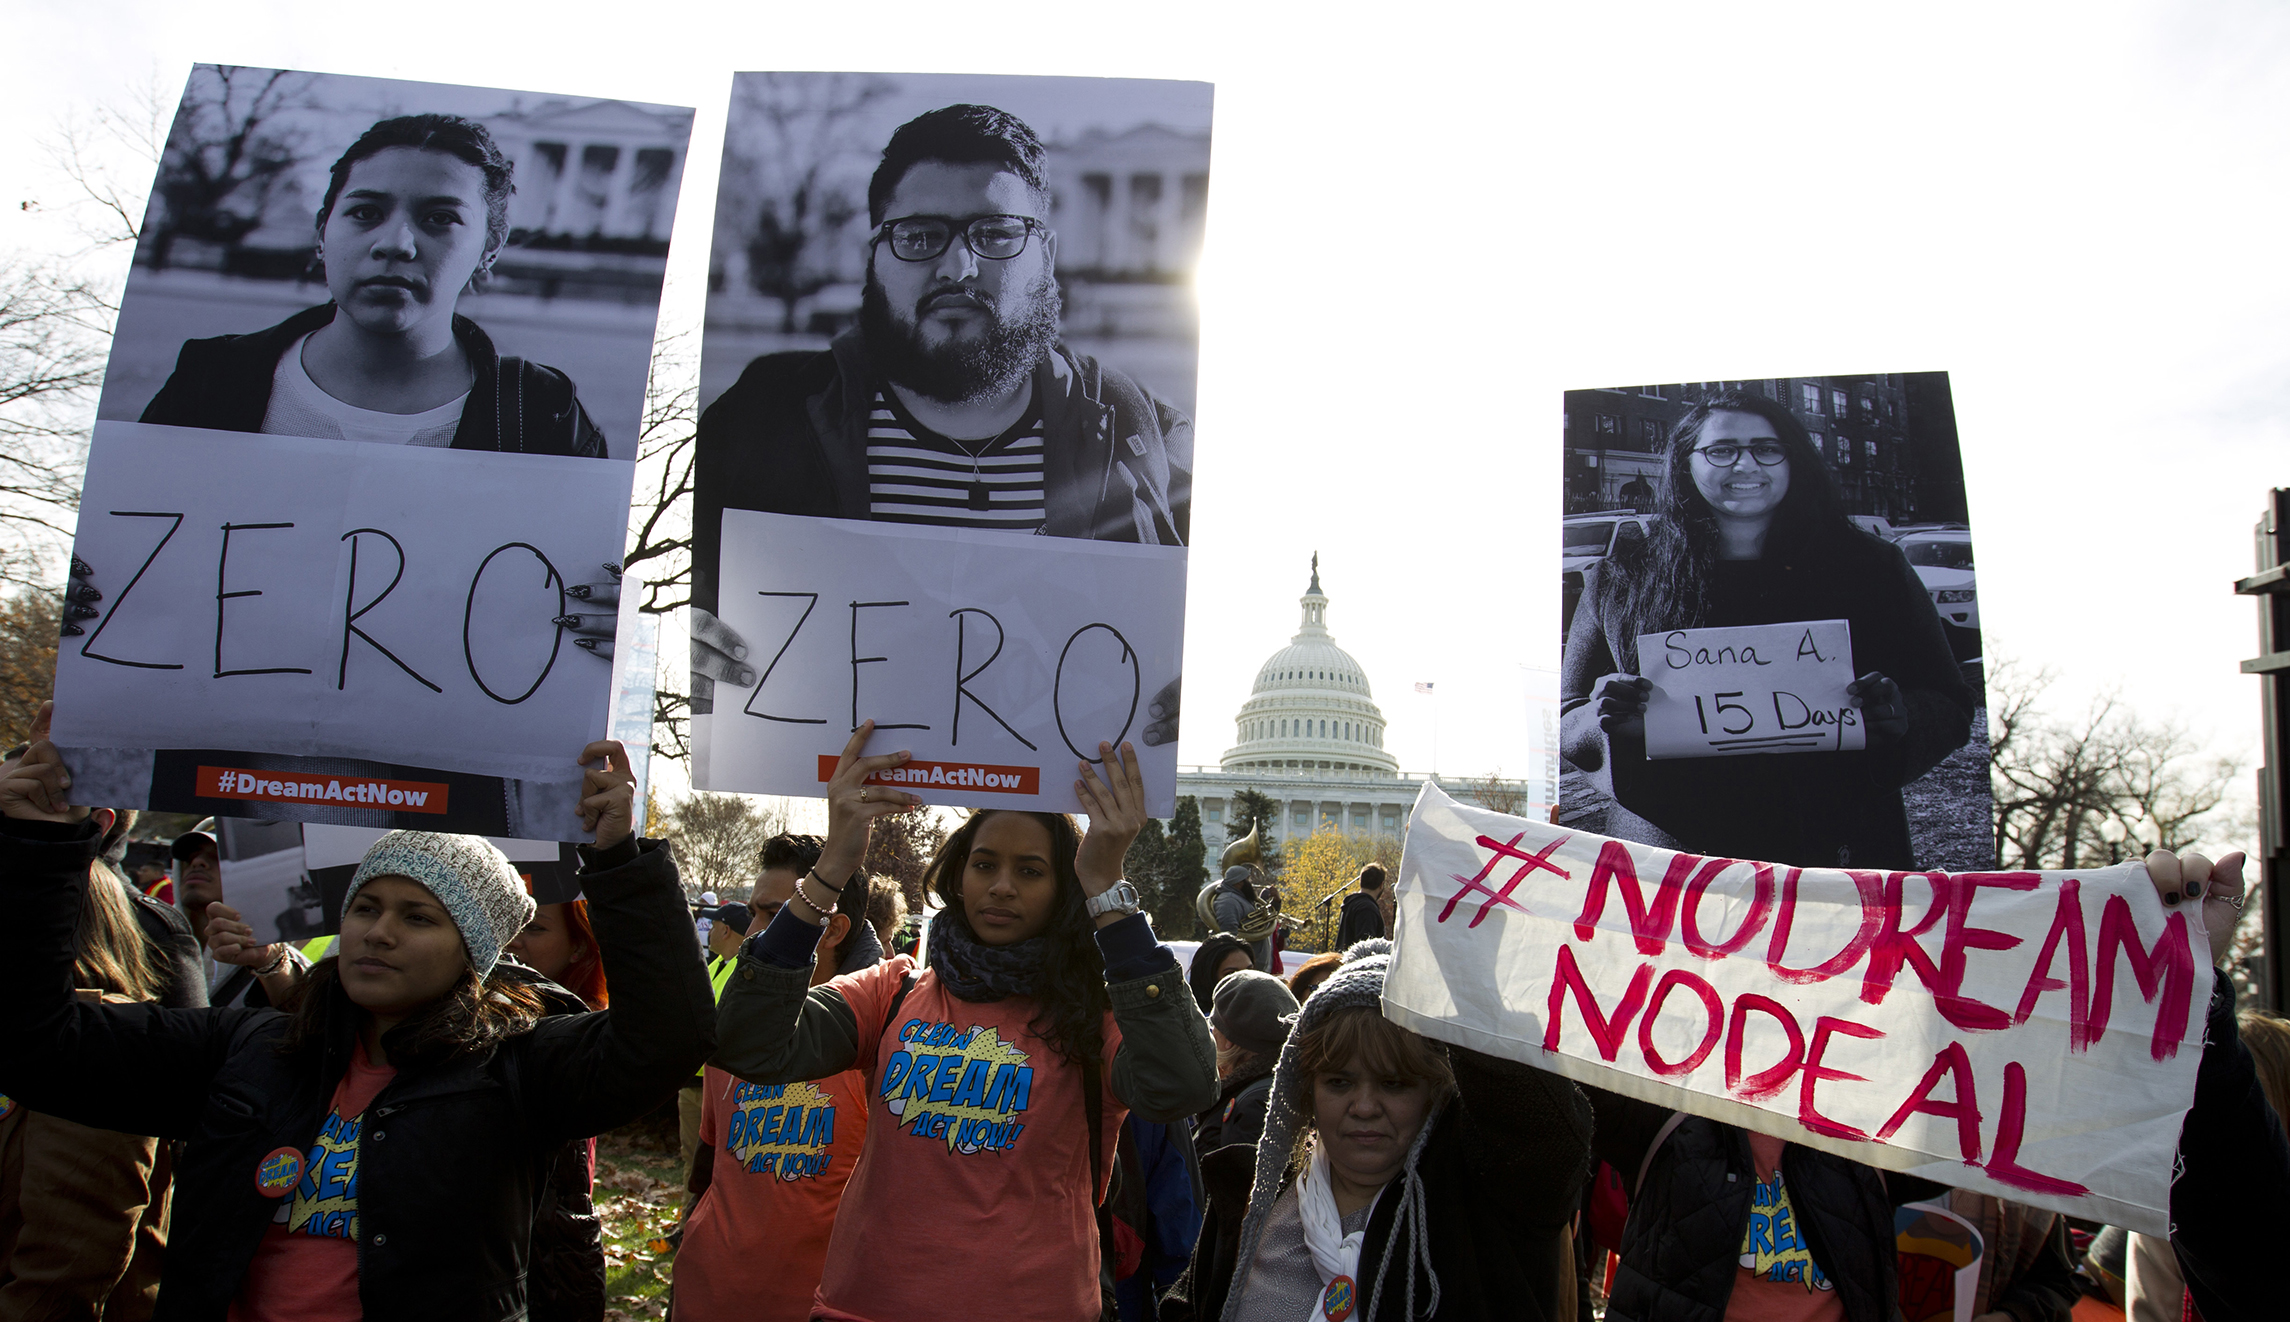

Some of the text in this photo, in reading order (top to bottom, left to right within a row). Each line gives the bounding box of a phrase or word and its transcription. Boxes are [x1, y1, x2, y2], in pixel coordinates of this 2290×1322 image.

[81, 511, 567, 704] ZERO
[1665, 628, 1838, 670] Sana A.
[743, 591, 1140, 764] ZERO
[1694, 691, 1858, 751] 15 Days
[218, 770, 429, 807] #DreamActNow
[869, 766, 1023, 788] reamActNow
[898, 1018, 974, 1050] CLEAN
[733, 1082, 786, 1104] CLEAN
[878, 1050, 1034, 1115] DREAM
[726, 1105, 836, 1151] DREAM
[910, 1111, 1025, 1150] ACT NOW!
[258, 1160, 299, 1185] DREAM
[750, 1152, 833, 1176] ACT NOW!
[307, 1210, 358, 1238] ACT
[1767, 1259, 1808, 1283] ACT
